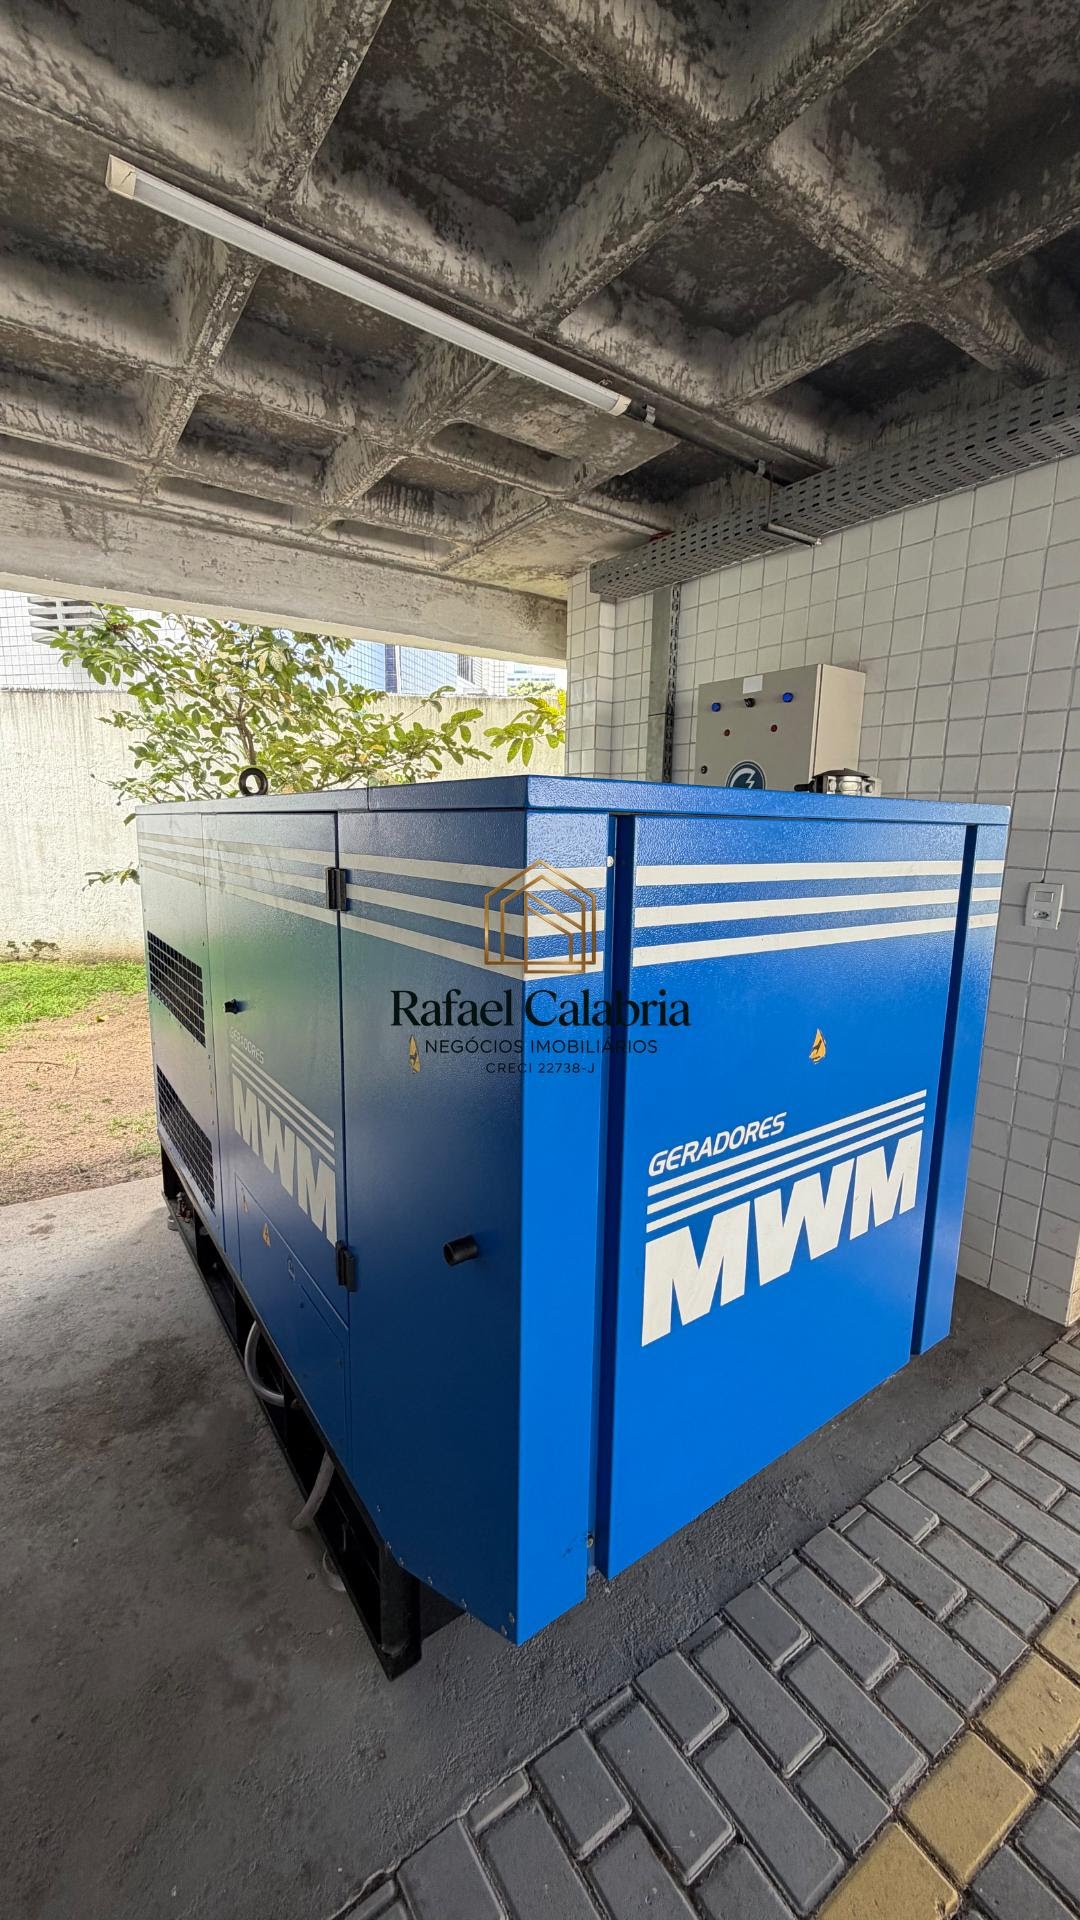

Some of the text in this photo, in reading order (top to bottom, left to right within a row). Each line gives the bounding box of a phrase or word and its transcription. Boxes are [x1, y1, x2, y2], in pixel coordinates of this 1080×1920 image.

[232, 1072, 338, 1249] MWM
[648, 1111, 788, 1177] GERADORES
[641, 1129, 923, 1348] MWM
